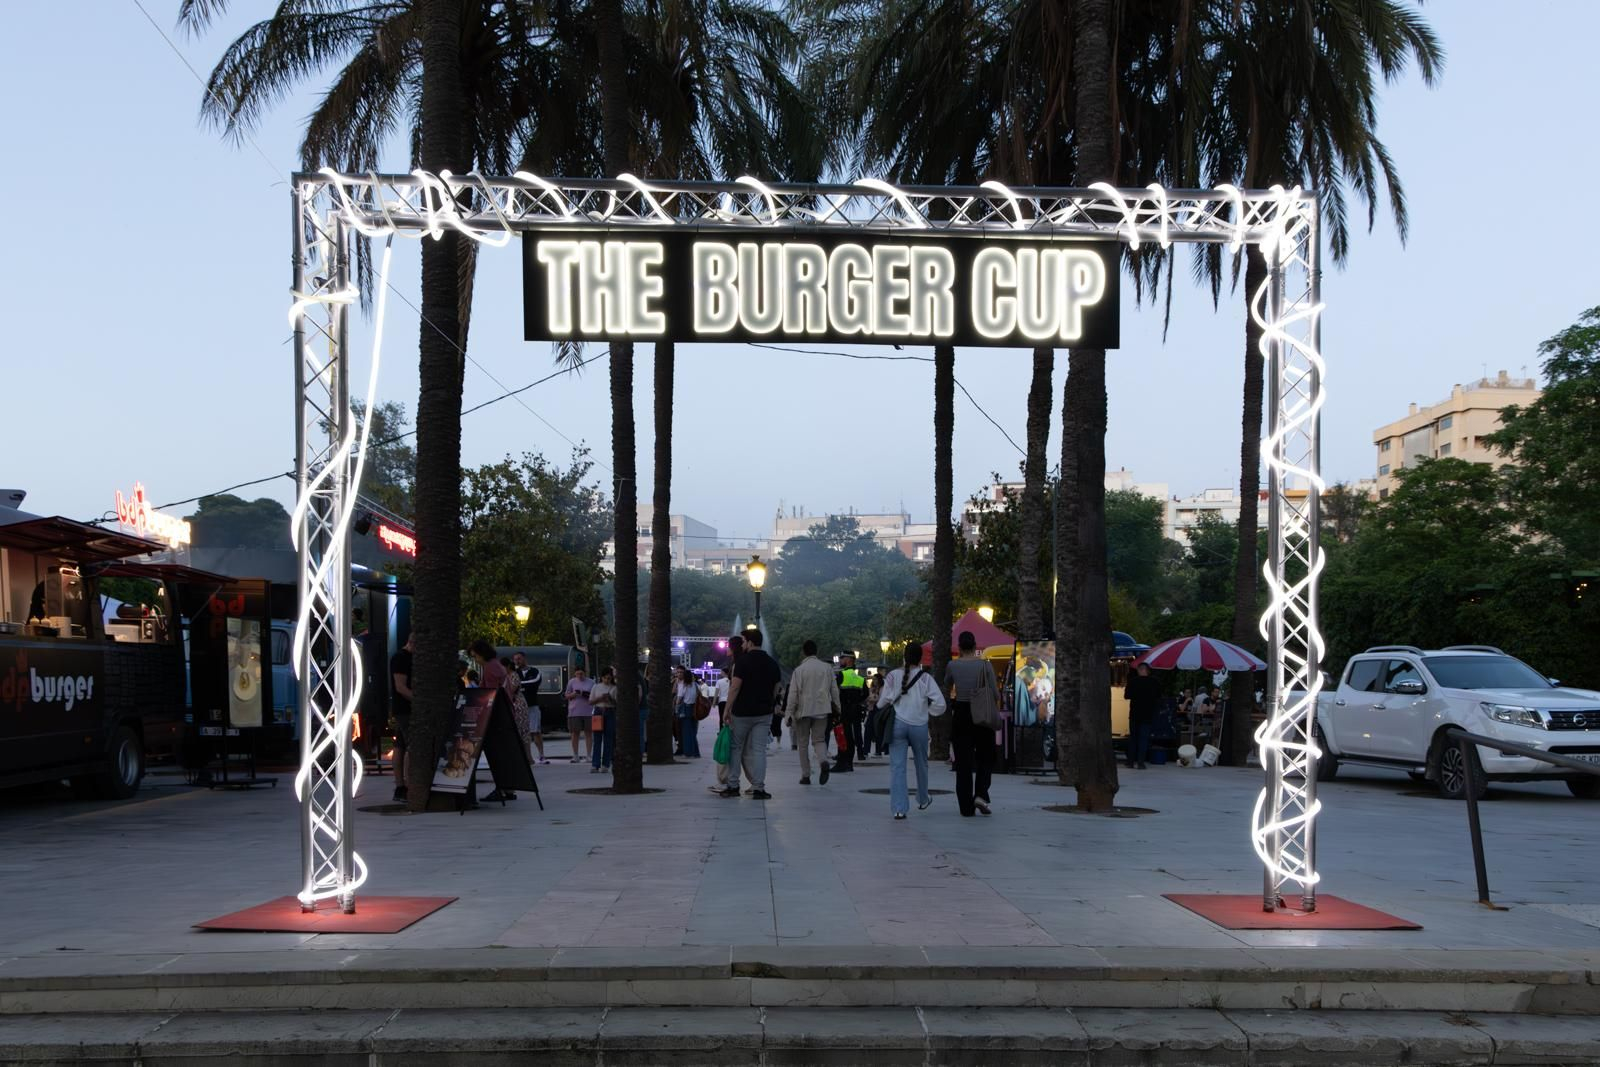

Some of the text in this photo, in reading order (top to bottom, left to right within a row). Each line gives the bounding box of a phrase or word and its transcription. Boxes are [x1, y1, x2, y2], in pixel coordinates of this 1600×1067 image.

[537, 240, 1106, 340] THE BURGER CUP
[30, 667, 94, 711] burger
